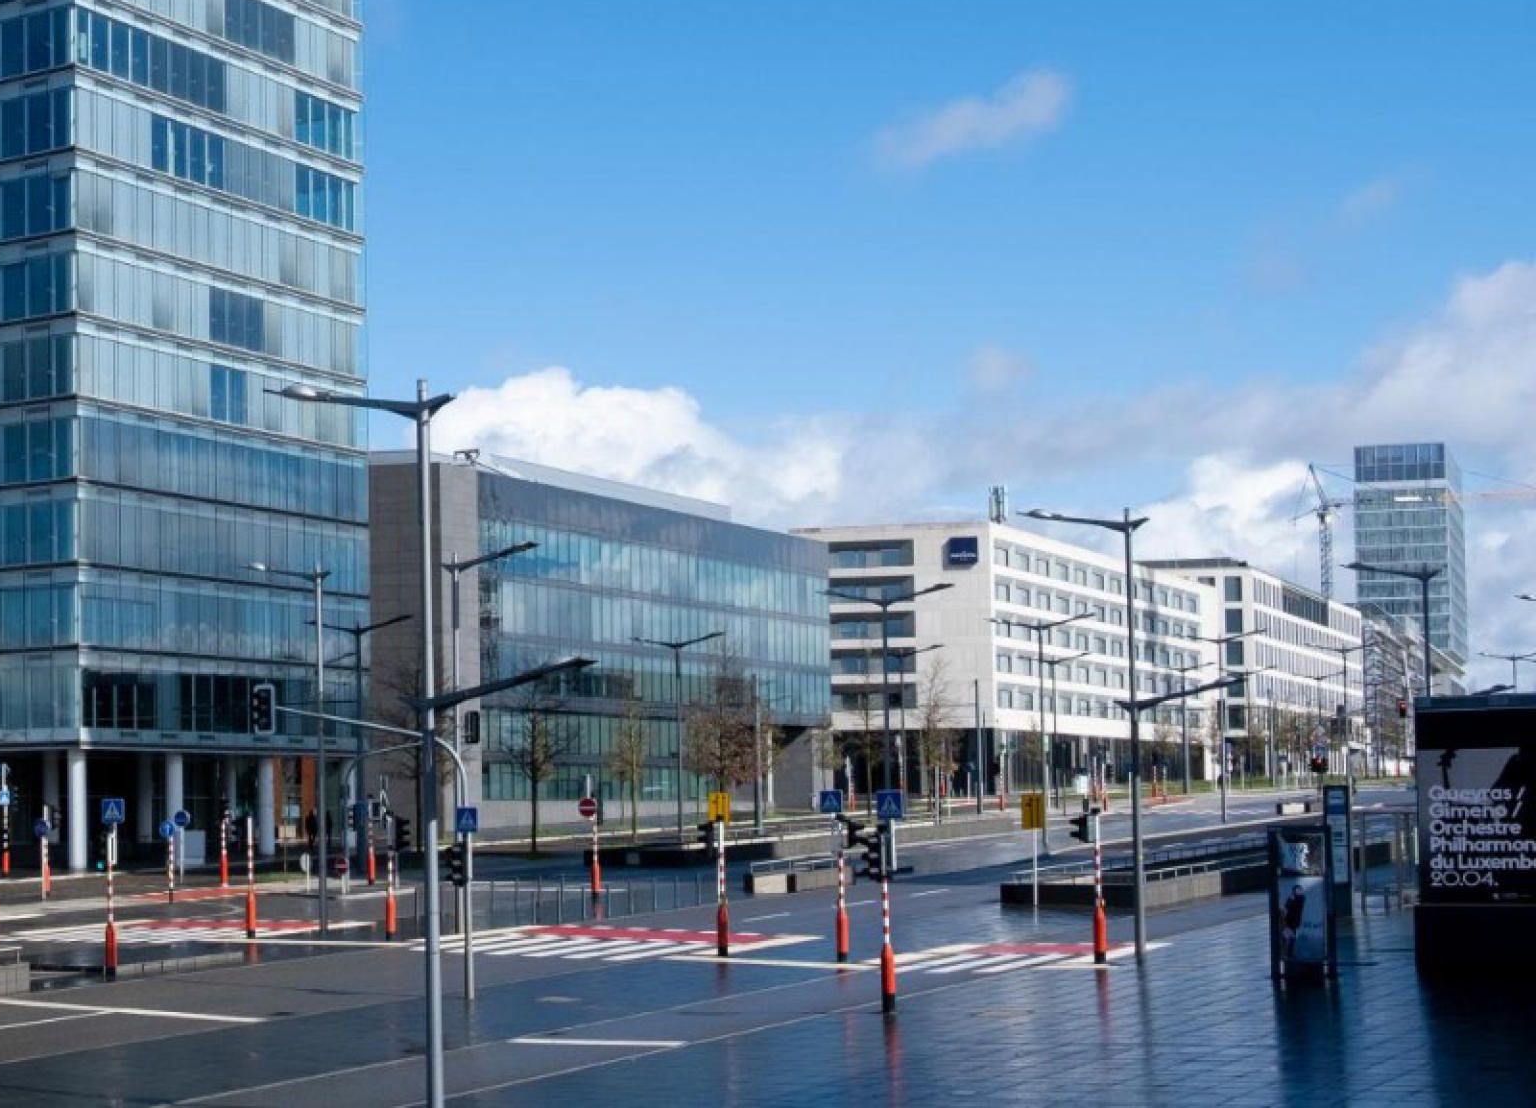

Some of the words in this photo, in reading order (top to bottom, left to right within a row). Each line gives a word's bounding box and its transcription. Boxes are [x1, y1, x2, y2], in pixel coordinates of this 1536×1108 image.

[1429, 802, 1508, 819] Gimeno
[1430, 819, 1522, 835] Orchestre
[1430, 853, 1454, 869] du
[1431, 871, 1499, 887] 20.04.
